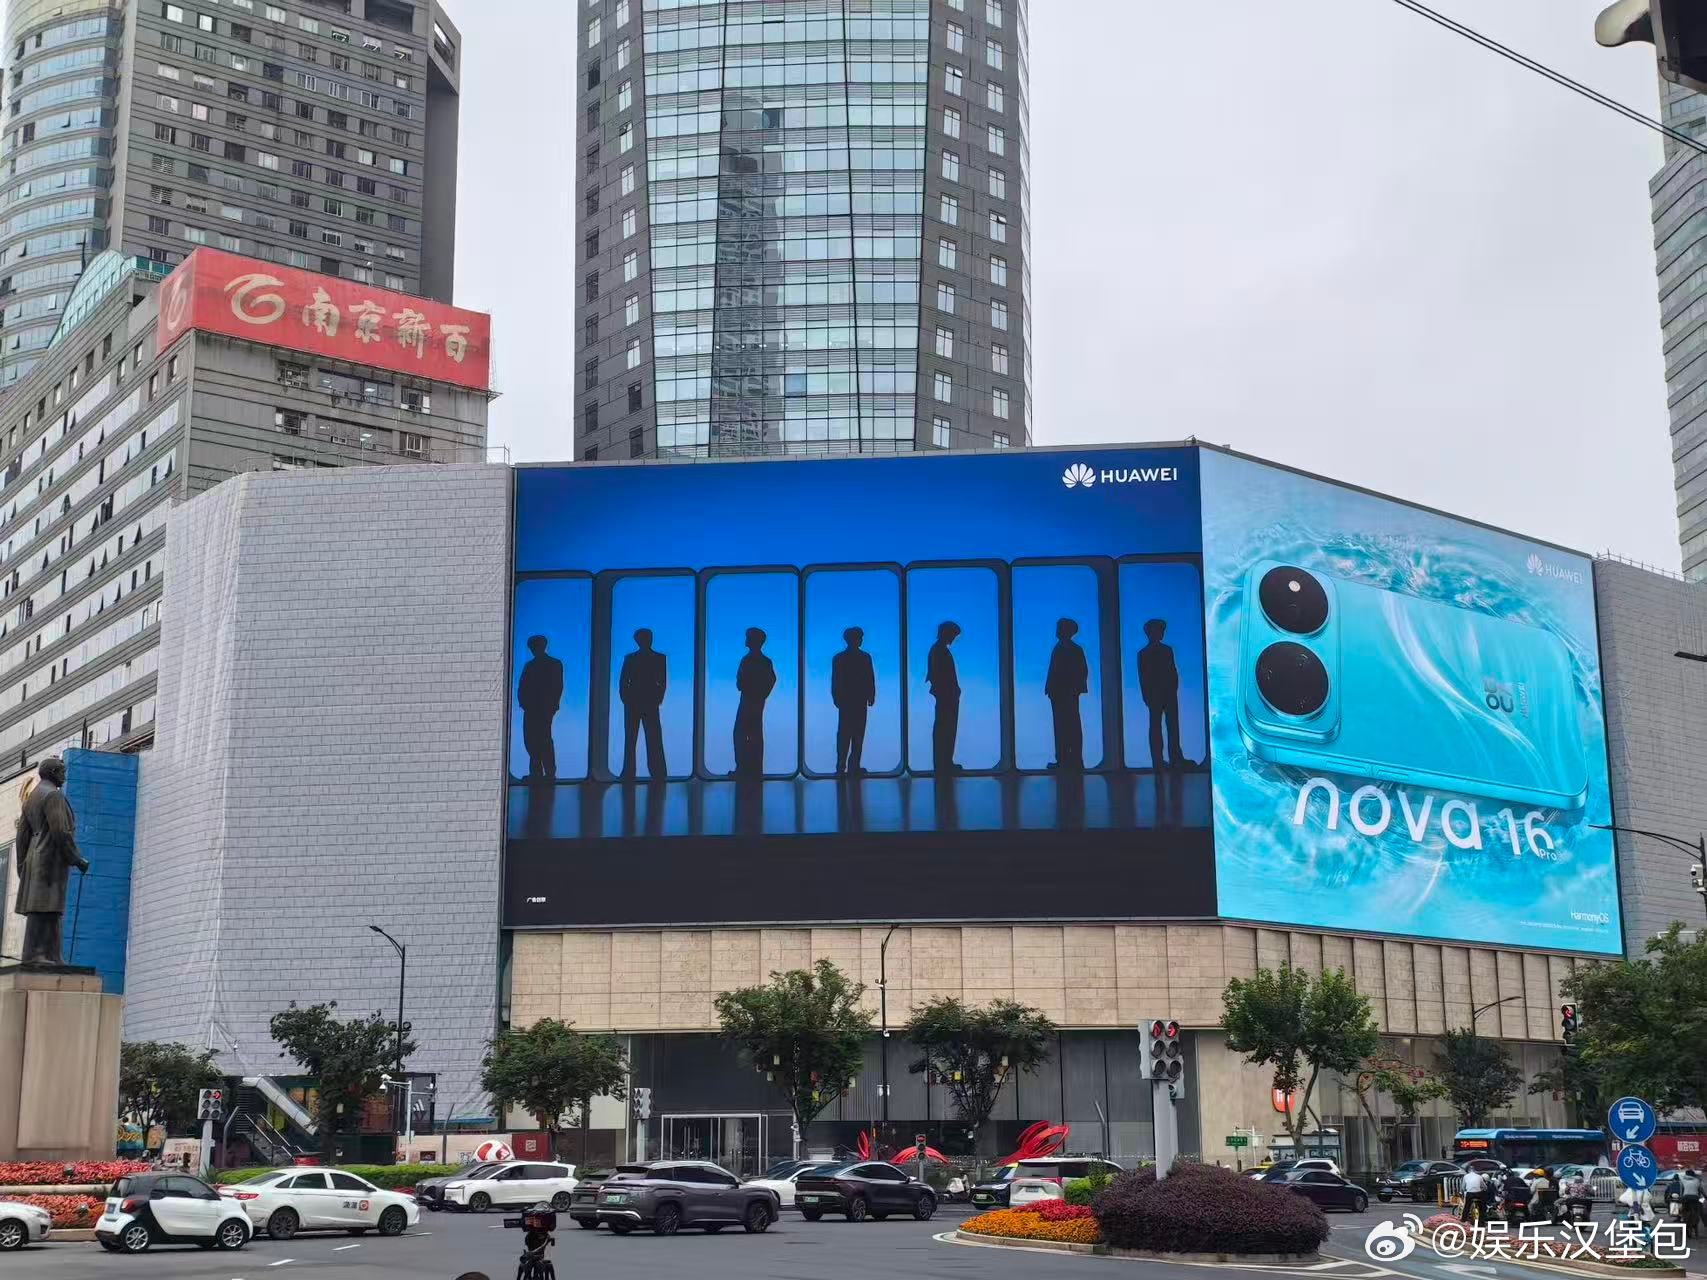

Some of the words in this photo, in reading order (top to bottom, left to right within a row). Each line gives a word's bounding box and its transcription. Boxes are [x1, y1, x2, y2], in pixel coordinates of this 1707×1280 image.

[302, 286, 471, 364] 南京新百
[1101, 467, 1178, 483] HUAWEI
[1545, 563, 1584, 585] HUAWEI
[1293, 777, 1483, 850] nova
[1497, 807, 1555, 858] 16
